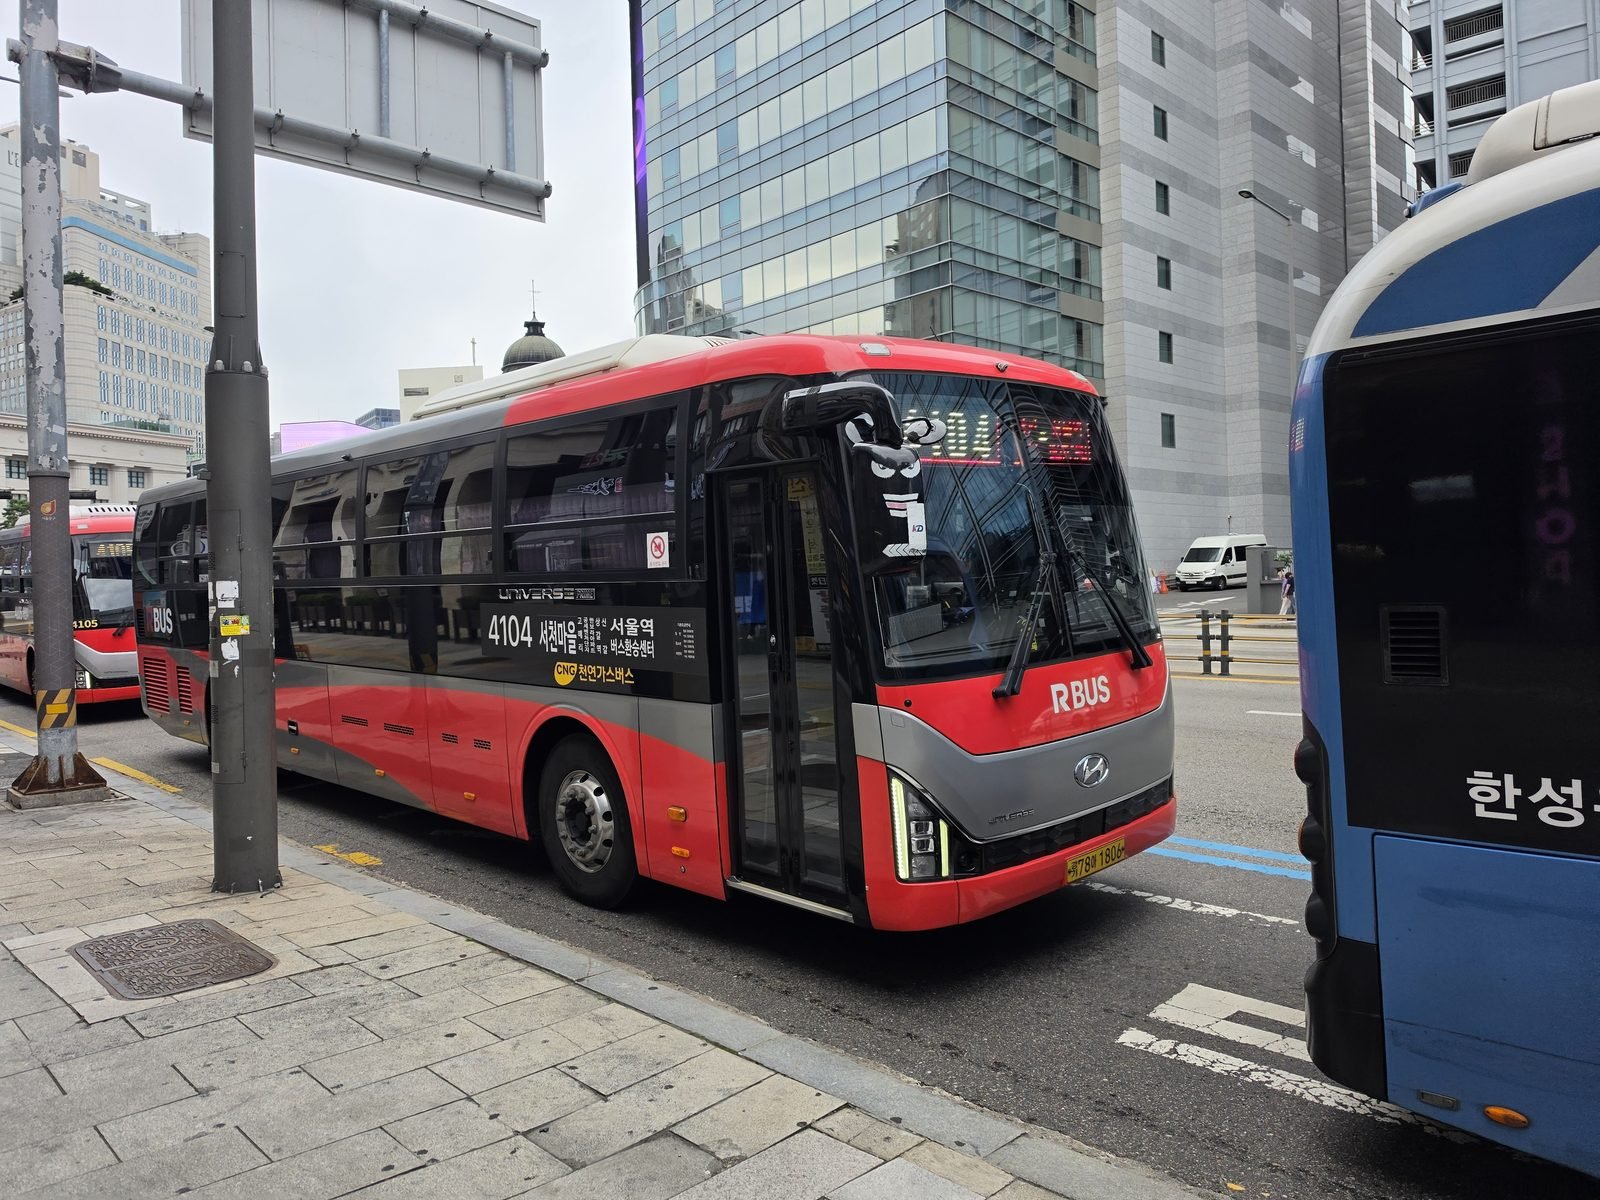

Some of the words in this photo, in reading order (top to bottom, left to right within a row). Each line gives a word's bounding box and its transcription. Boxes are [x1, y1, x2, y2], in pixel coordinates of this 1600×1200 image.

[498, 587, 575, 600] UNIVERSE
[153, 607, 173, 634] BUS
[488, 614, 533, 648] 4104
[610, 617, 654, 637] 서울역
[539, 620, 577, 655] 서천마을
[610, 638, 656, 659] 버스환승센터
[556, 665, 576, 676] CNG
[578, 664, 635, 685] 천연가스버스
[1465, 770, 1600, 828] 한성
[1099, 843, 1122, 867] 1806
